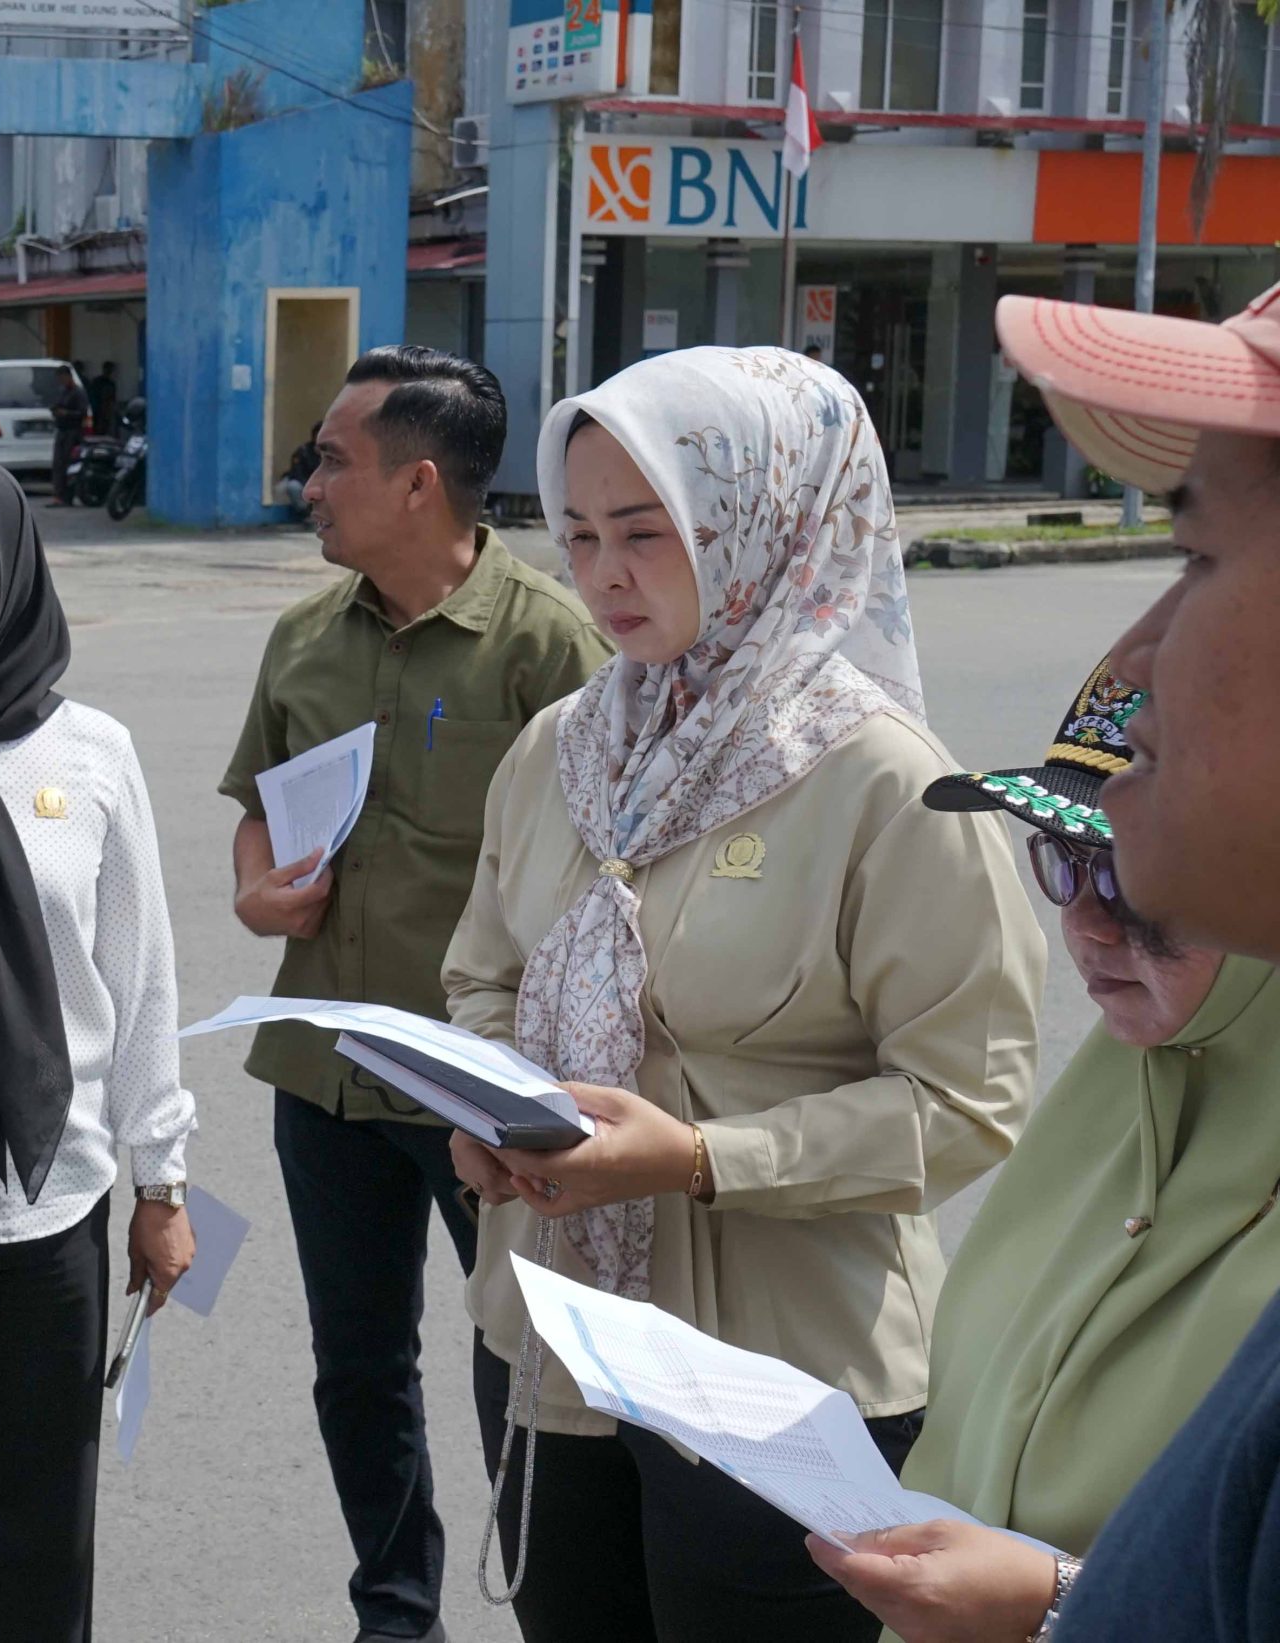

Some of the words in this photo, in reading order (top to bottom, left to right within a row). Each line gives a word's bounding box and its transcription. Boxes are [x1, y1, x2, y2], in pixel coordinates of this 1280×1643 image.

[566, 0, 601, 31] 24
[667, 146, 808, 230] BNI
[1078, 717, 1114, 733] DPRD
